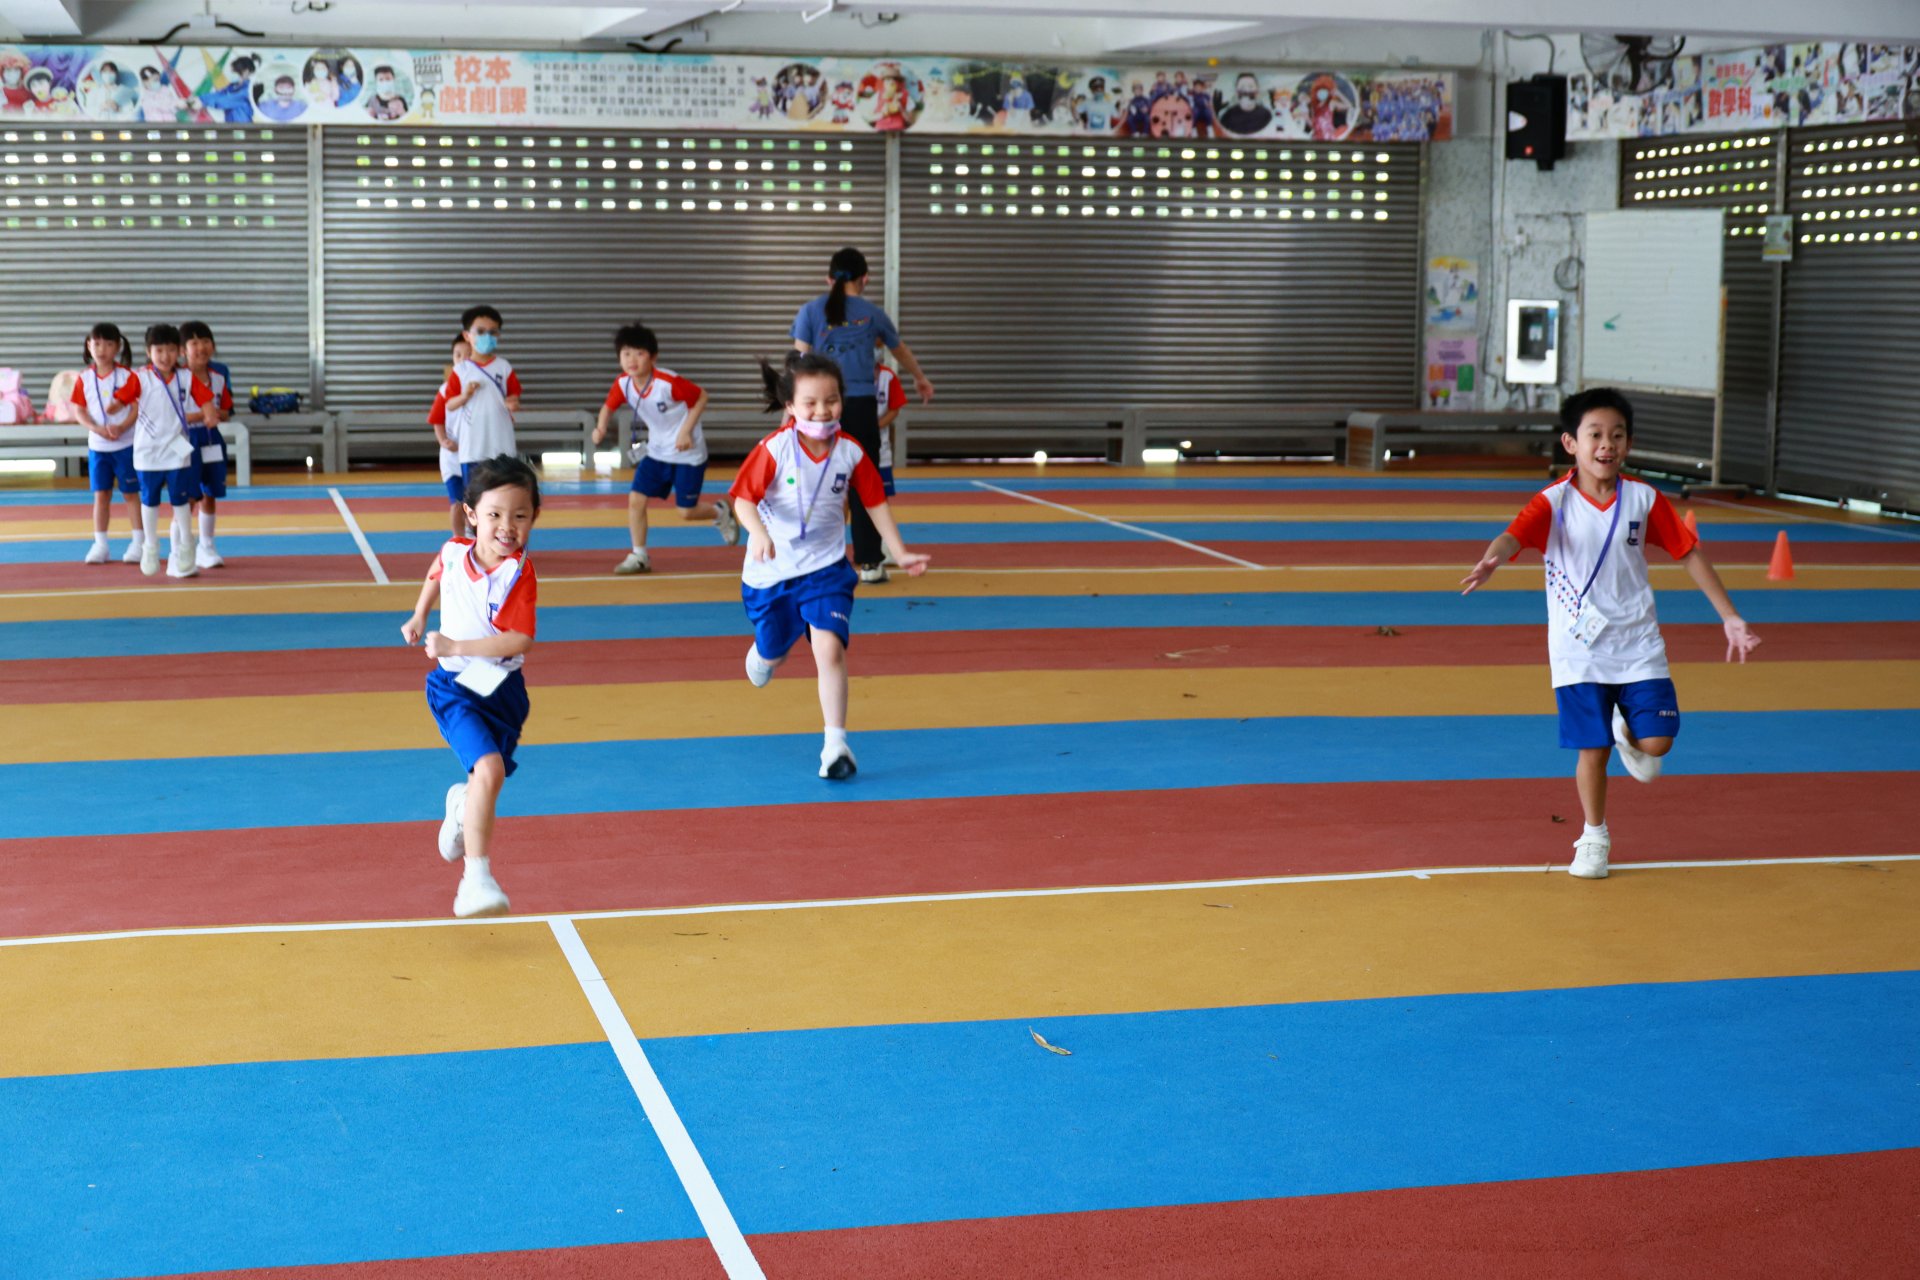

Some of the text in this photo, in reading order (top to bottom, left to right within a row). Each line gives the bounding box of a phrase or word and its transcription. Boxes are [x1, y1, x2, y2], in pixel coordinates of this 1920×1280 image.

[454, 55, 512, 84] 校本
[440, 85, 527, 114] 戲劇課
